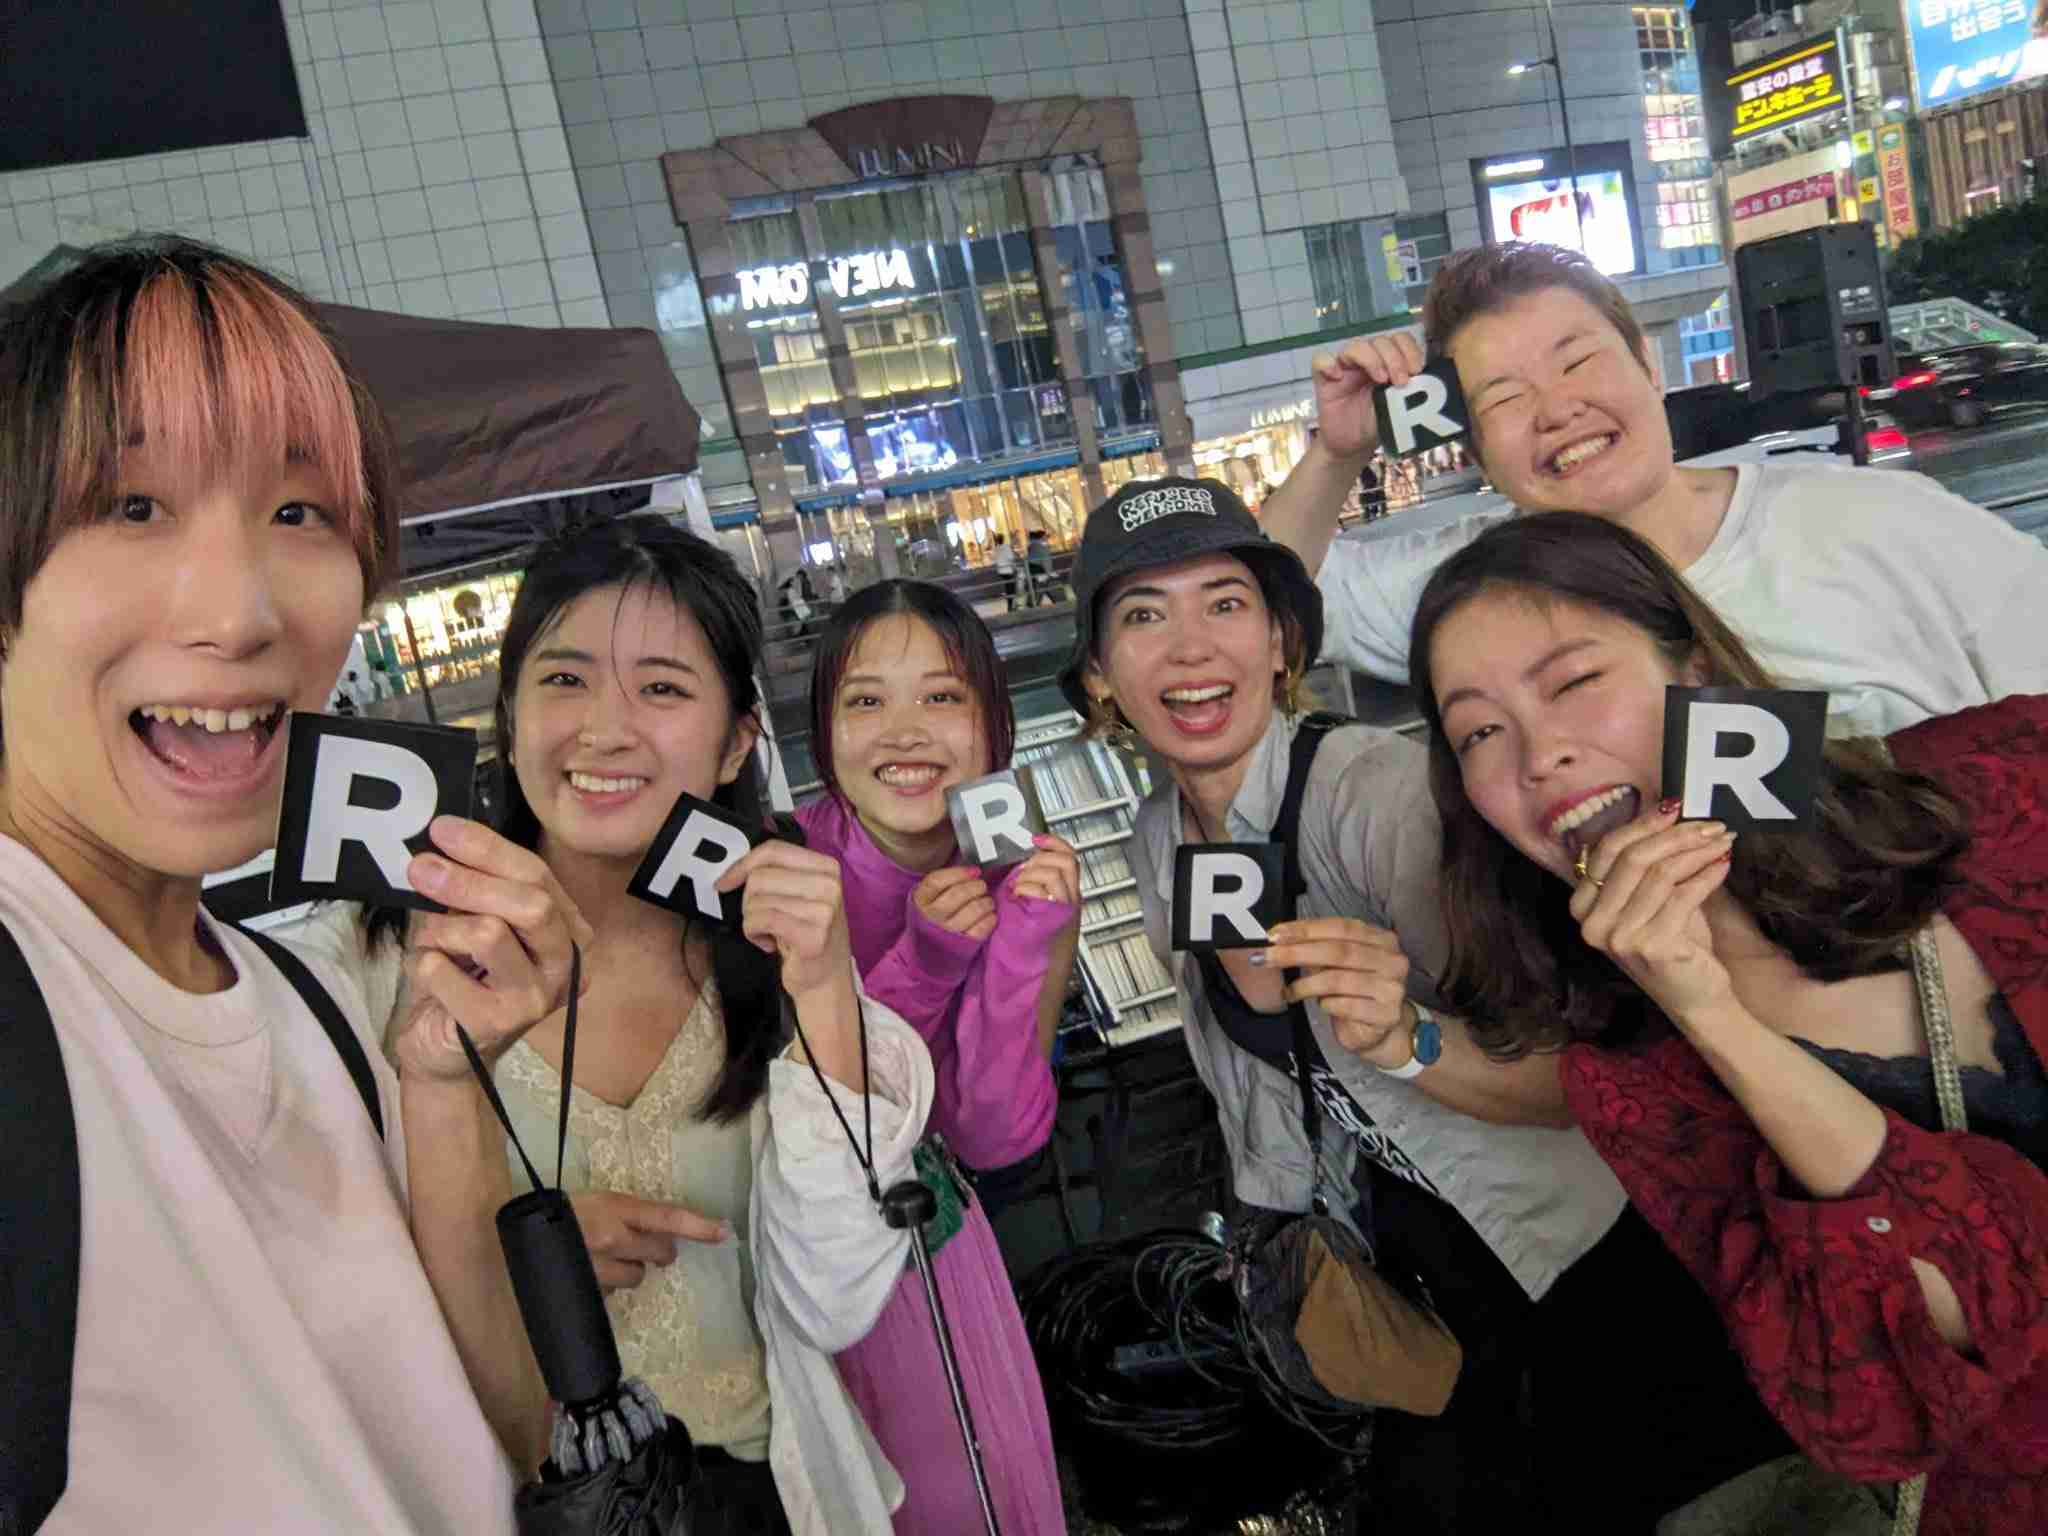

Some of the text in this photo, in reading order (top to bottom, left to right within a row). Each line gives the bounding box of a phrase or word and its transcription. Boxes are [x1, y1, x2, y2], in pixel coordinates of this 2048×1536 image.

[1385, 374, 1464, 454] R
[1681, 702, 1798, 820] R
[302, 733, 439, 891] R
[960, 782, 1033, 863] R
[647, 808, 751, 920] R
[1190, 853, 1269, 942] R
